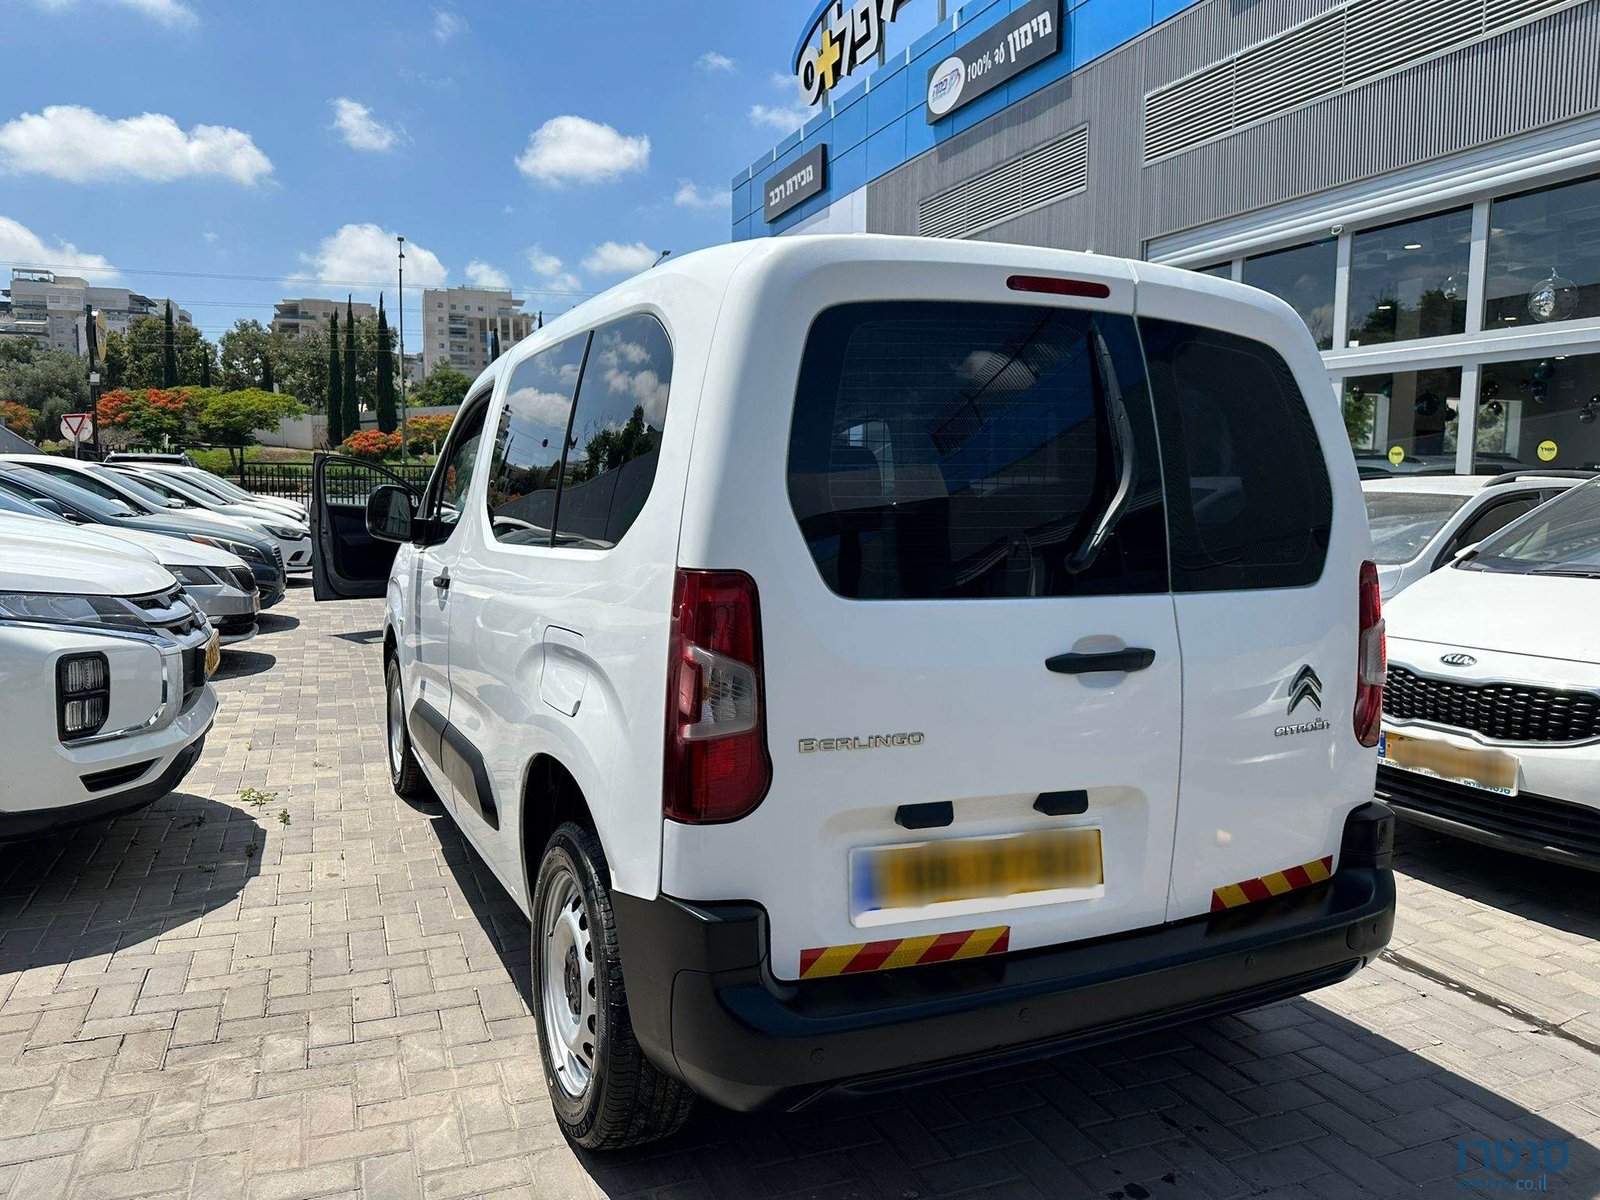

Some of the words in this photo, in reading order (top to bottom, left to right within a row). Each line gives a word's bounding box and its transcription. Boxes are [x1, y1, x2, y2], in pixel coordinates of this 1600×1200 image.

[1007, 10, 1052, 63] מימון
[993, 42, 1005, 64] עד
[967, 51, 991, 82] 100%
[786, 164, 814, 196] מכירת
[769, 183, 785, 207] רכב
[1442, 654, 1475, 666] KIA
[799, 732, 925, 753] BERLINGO
